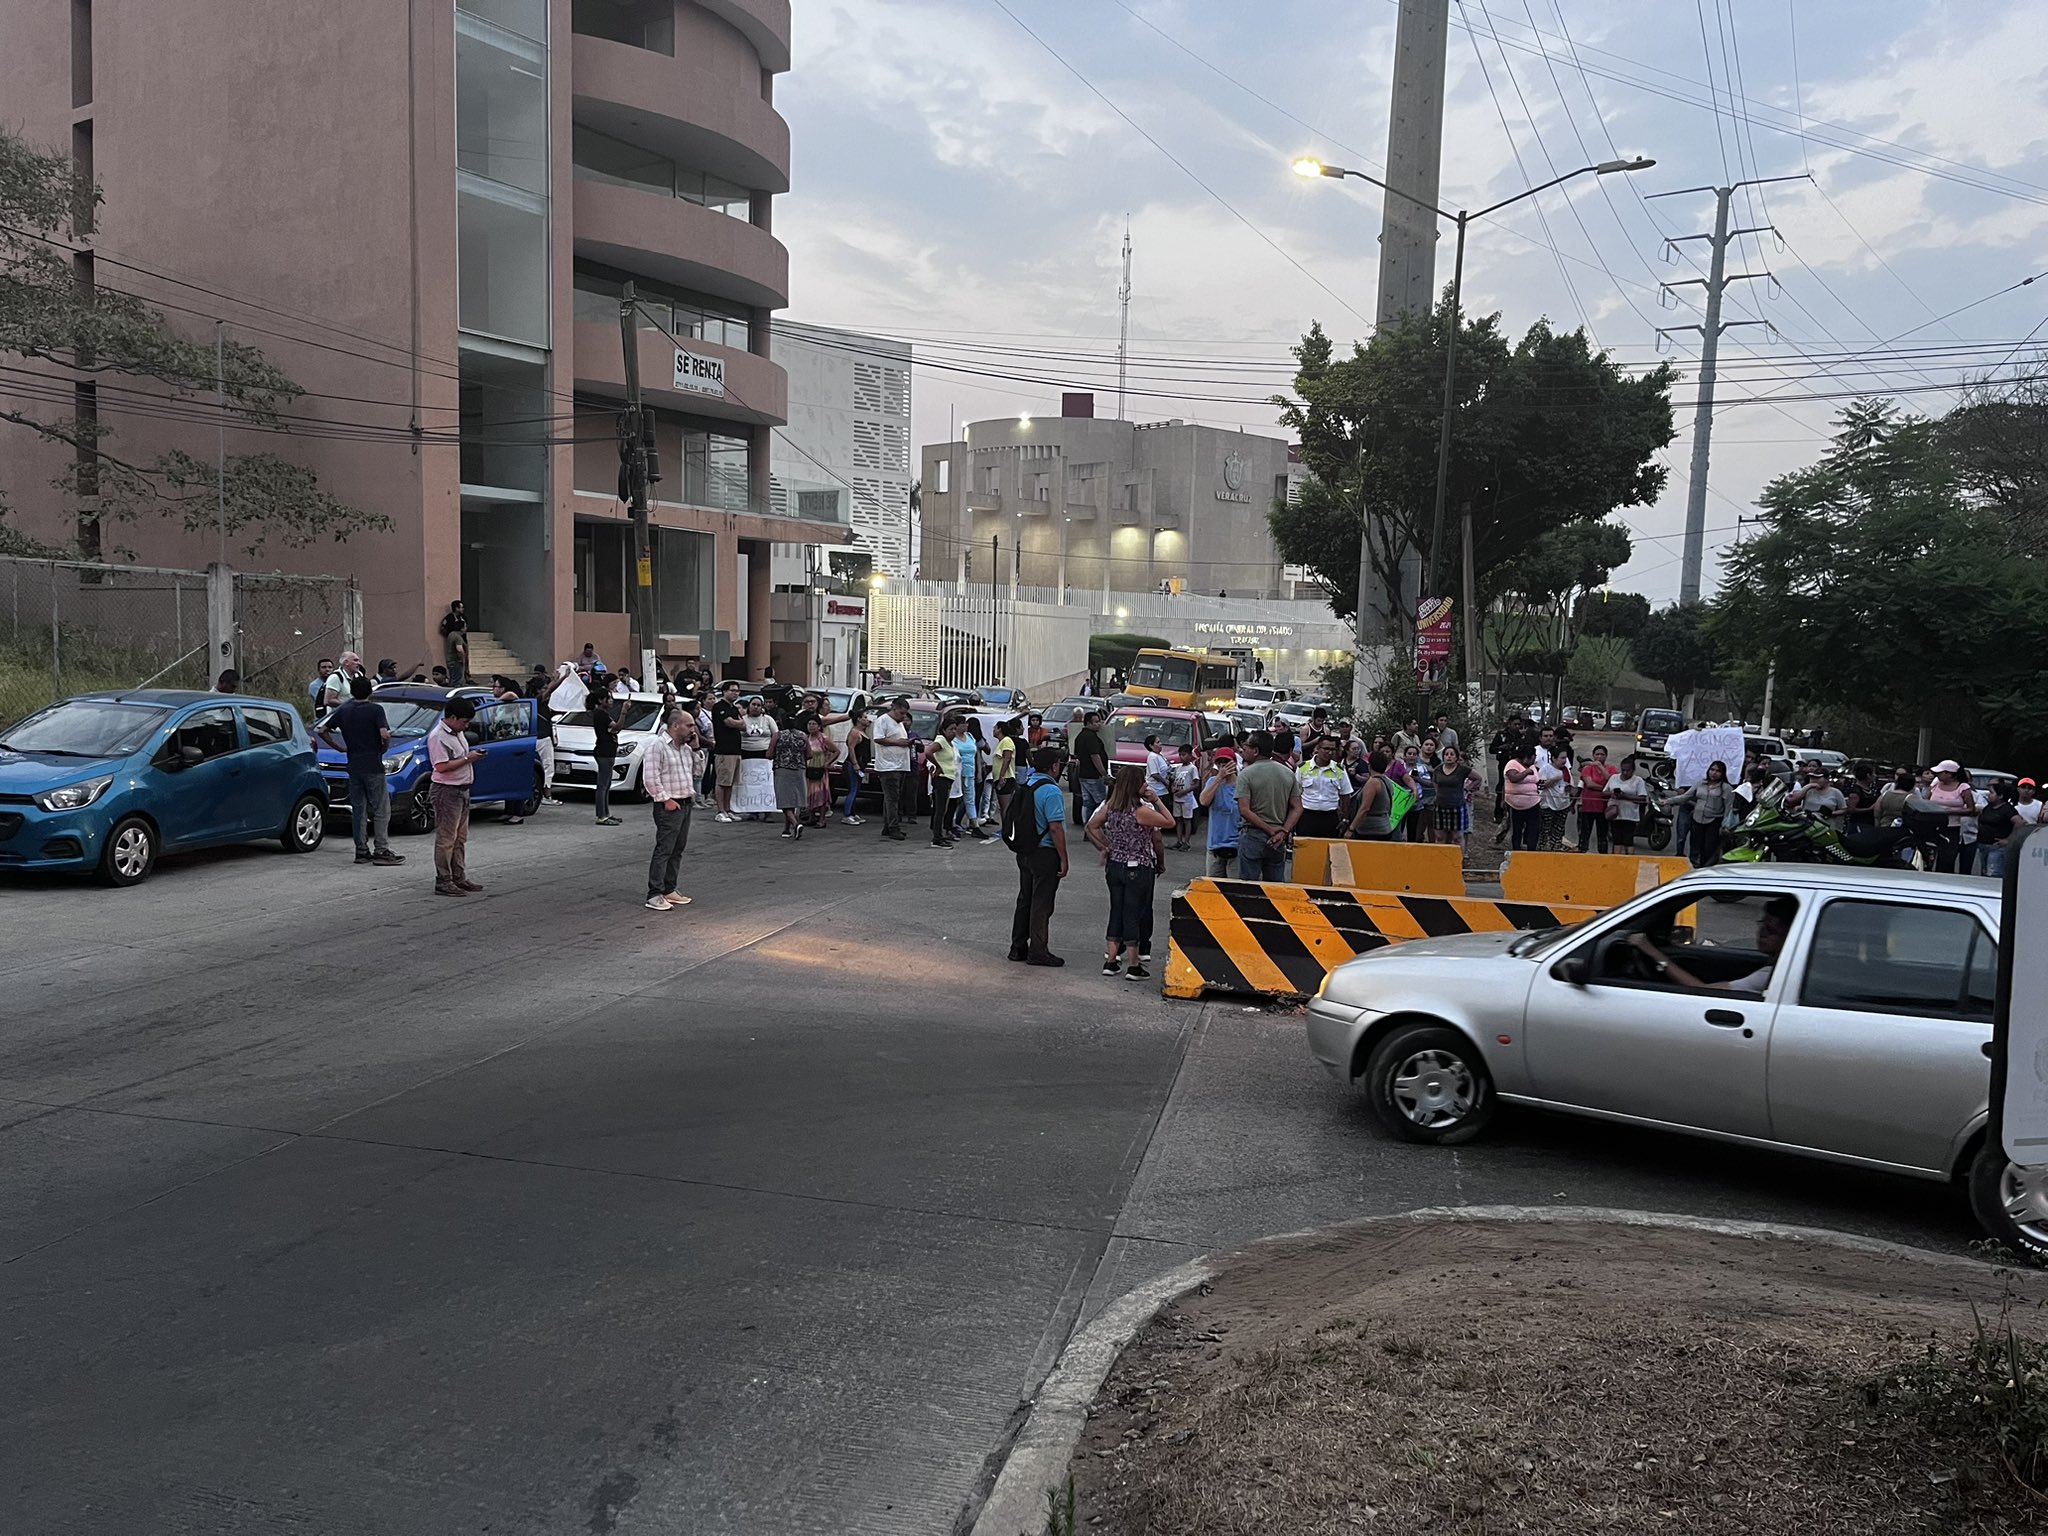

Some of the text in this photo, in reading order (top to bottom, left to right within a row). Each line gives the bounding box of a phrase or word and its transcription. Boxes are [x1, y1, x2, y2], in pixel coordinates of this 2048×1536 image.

[676, 354, 723, 382] SE RENTA
[1216, 490, 1252, 503] VERACRUZ
[1416, 596, 1454, 630] UNIVERSIDAD
